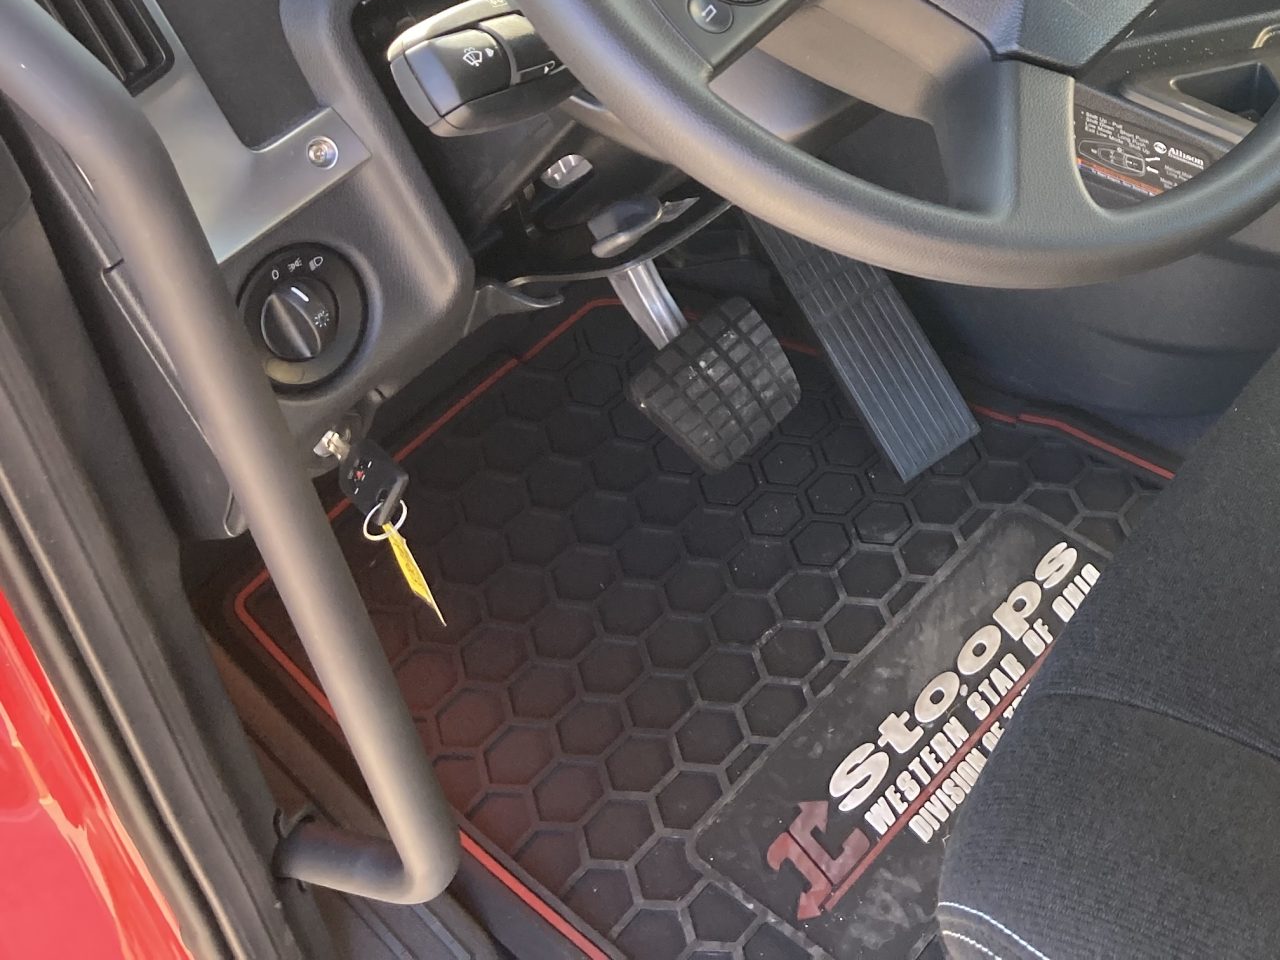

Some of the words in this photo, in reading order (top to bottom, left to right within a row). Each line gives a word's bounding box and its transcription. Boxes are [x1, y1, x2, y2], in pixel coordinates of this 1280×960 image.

[829, 542, 1078, 812] Stoops
[864, 716, 969, 836] WESTERN
[966, 653, 1026, 721] STAR
[1022, 618, 1054, 656] OF
[908, 747, 988, 843] DIVISION
